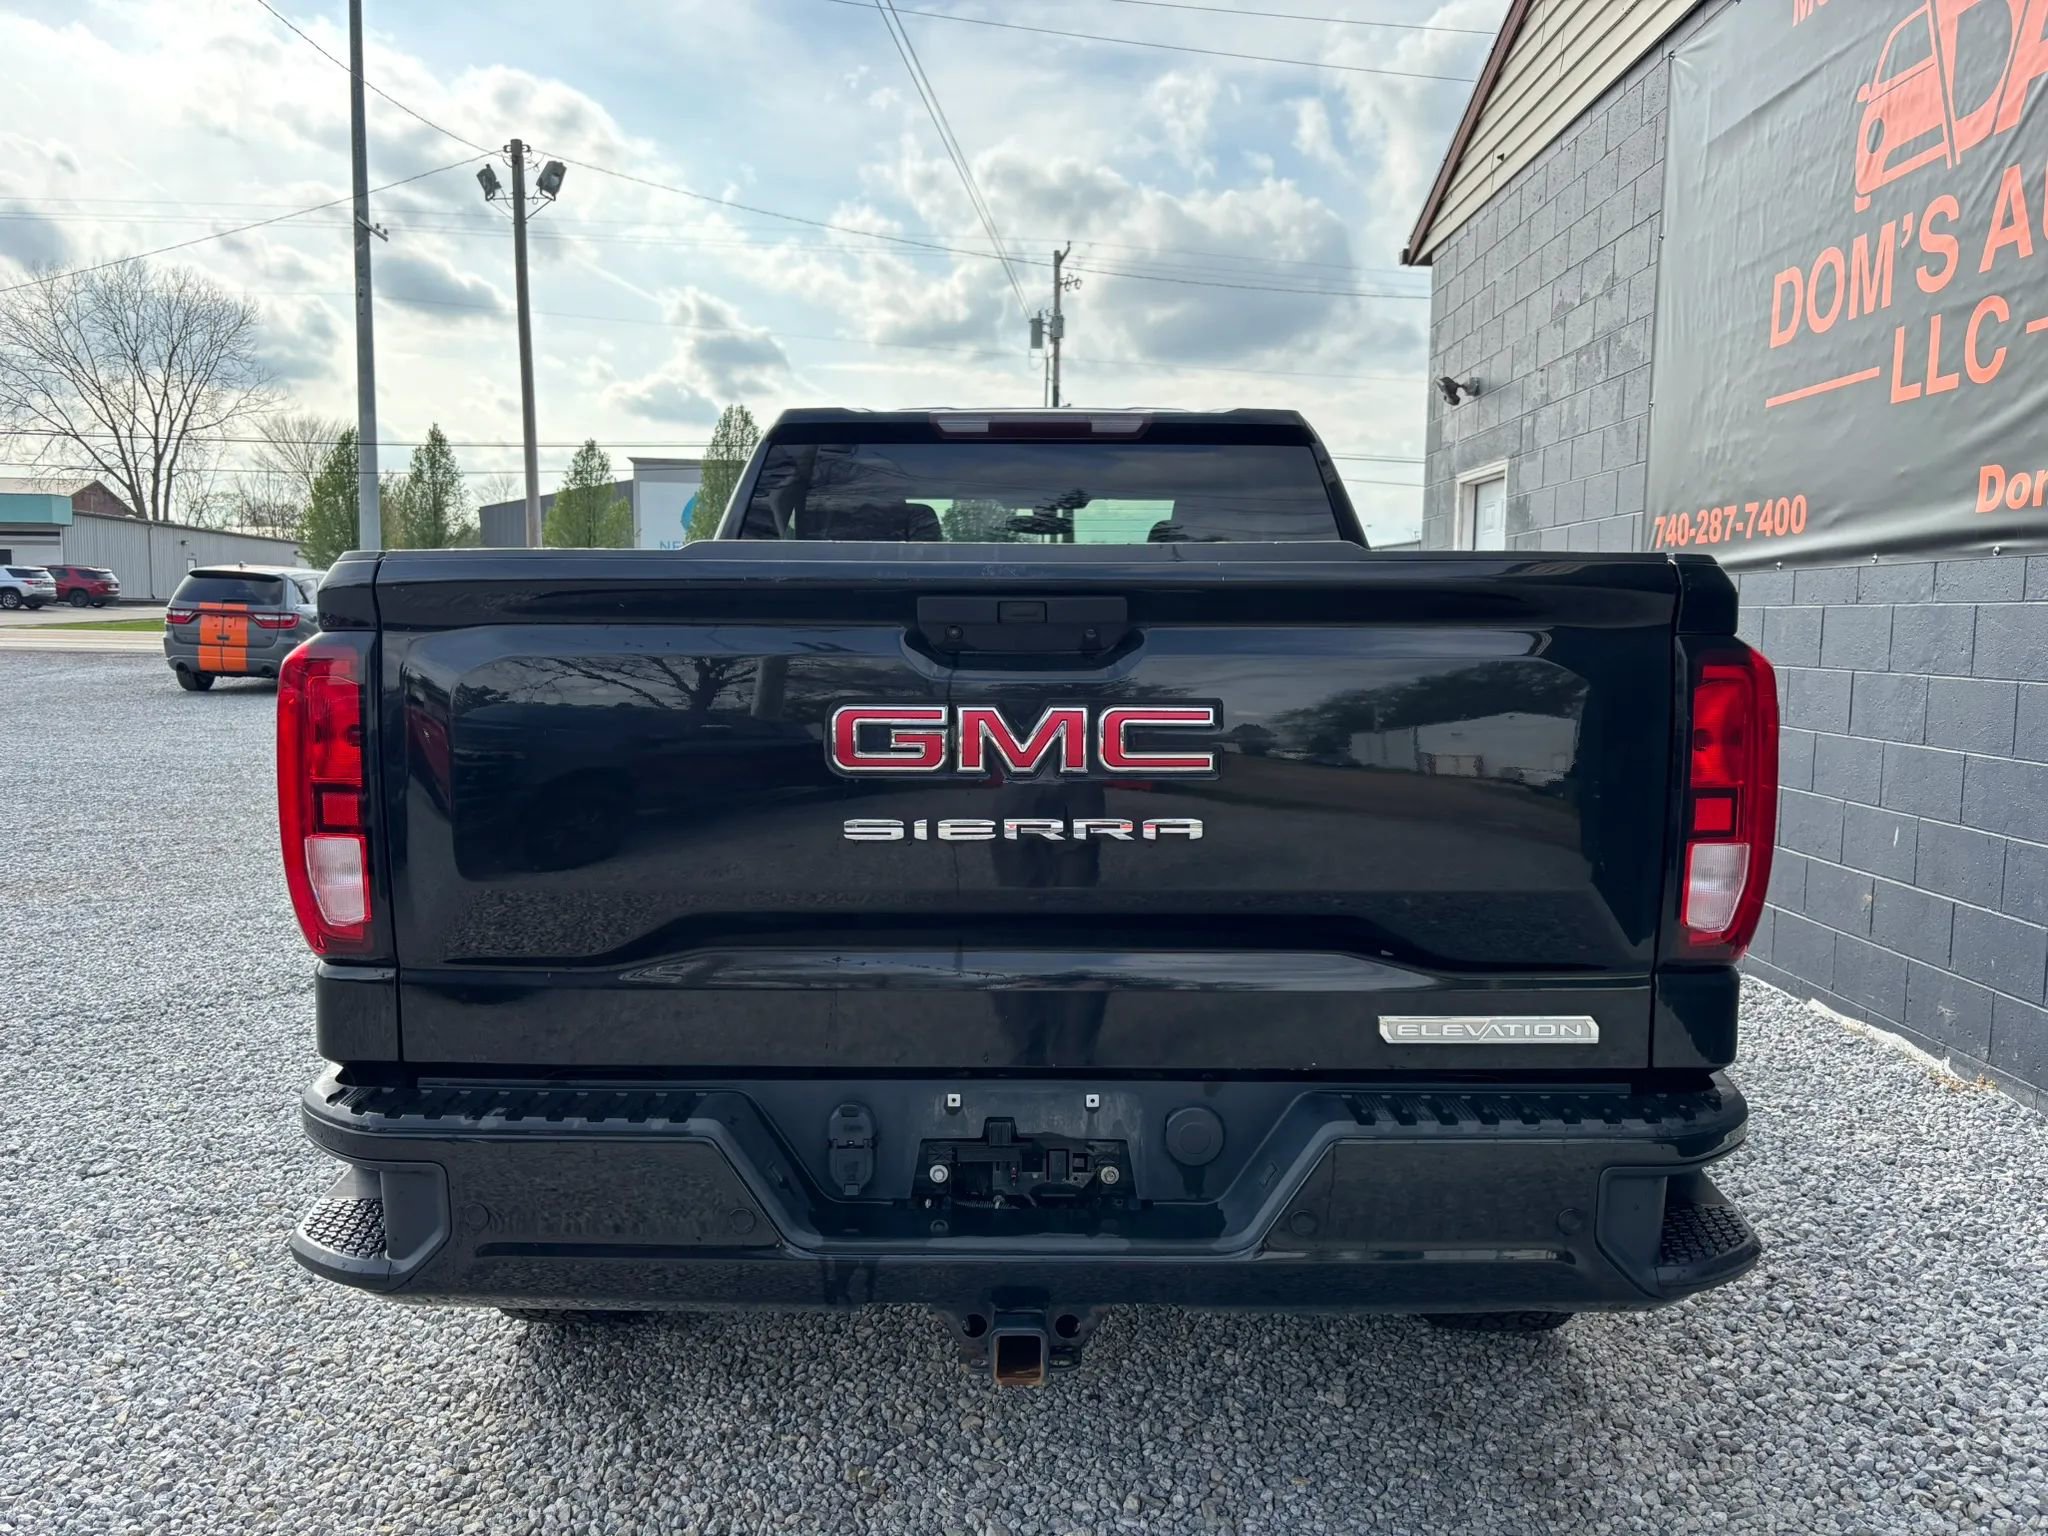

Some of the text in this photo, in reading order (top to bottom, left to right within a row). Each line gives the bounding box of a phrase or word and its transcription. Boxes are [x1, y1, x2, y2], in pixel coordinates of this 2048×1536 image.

[1769, 155, 2048, 349] DOM'S A
[1890, 295, 2010, 404] LLC
[1654, 494, 1808, 549] 740-287-7400
[831, 704, 1214, 773] GMC
[843, 818, 1204, 841] SIERRA
[1396, 1021, 1584, 1038] ELEVATION
